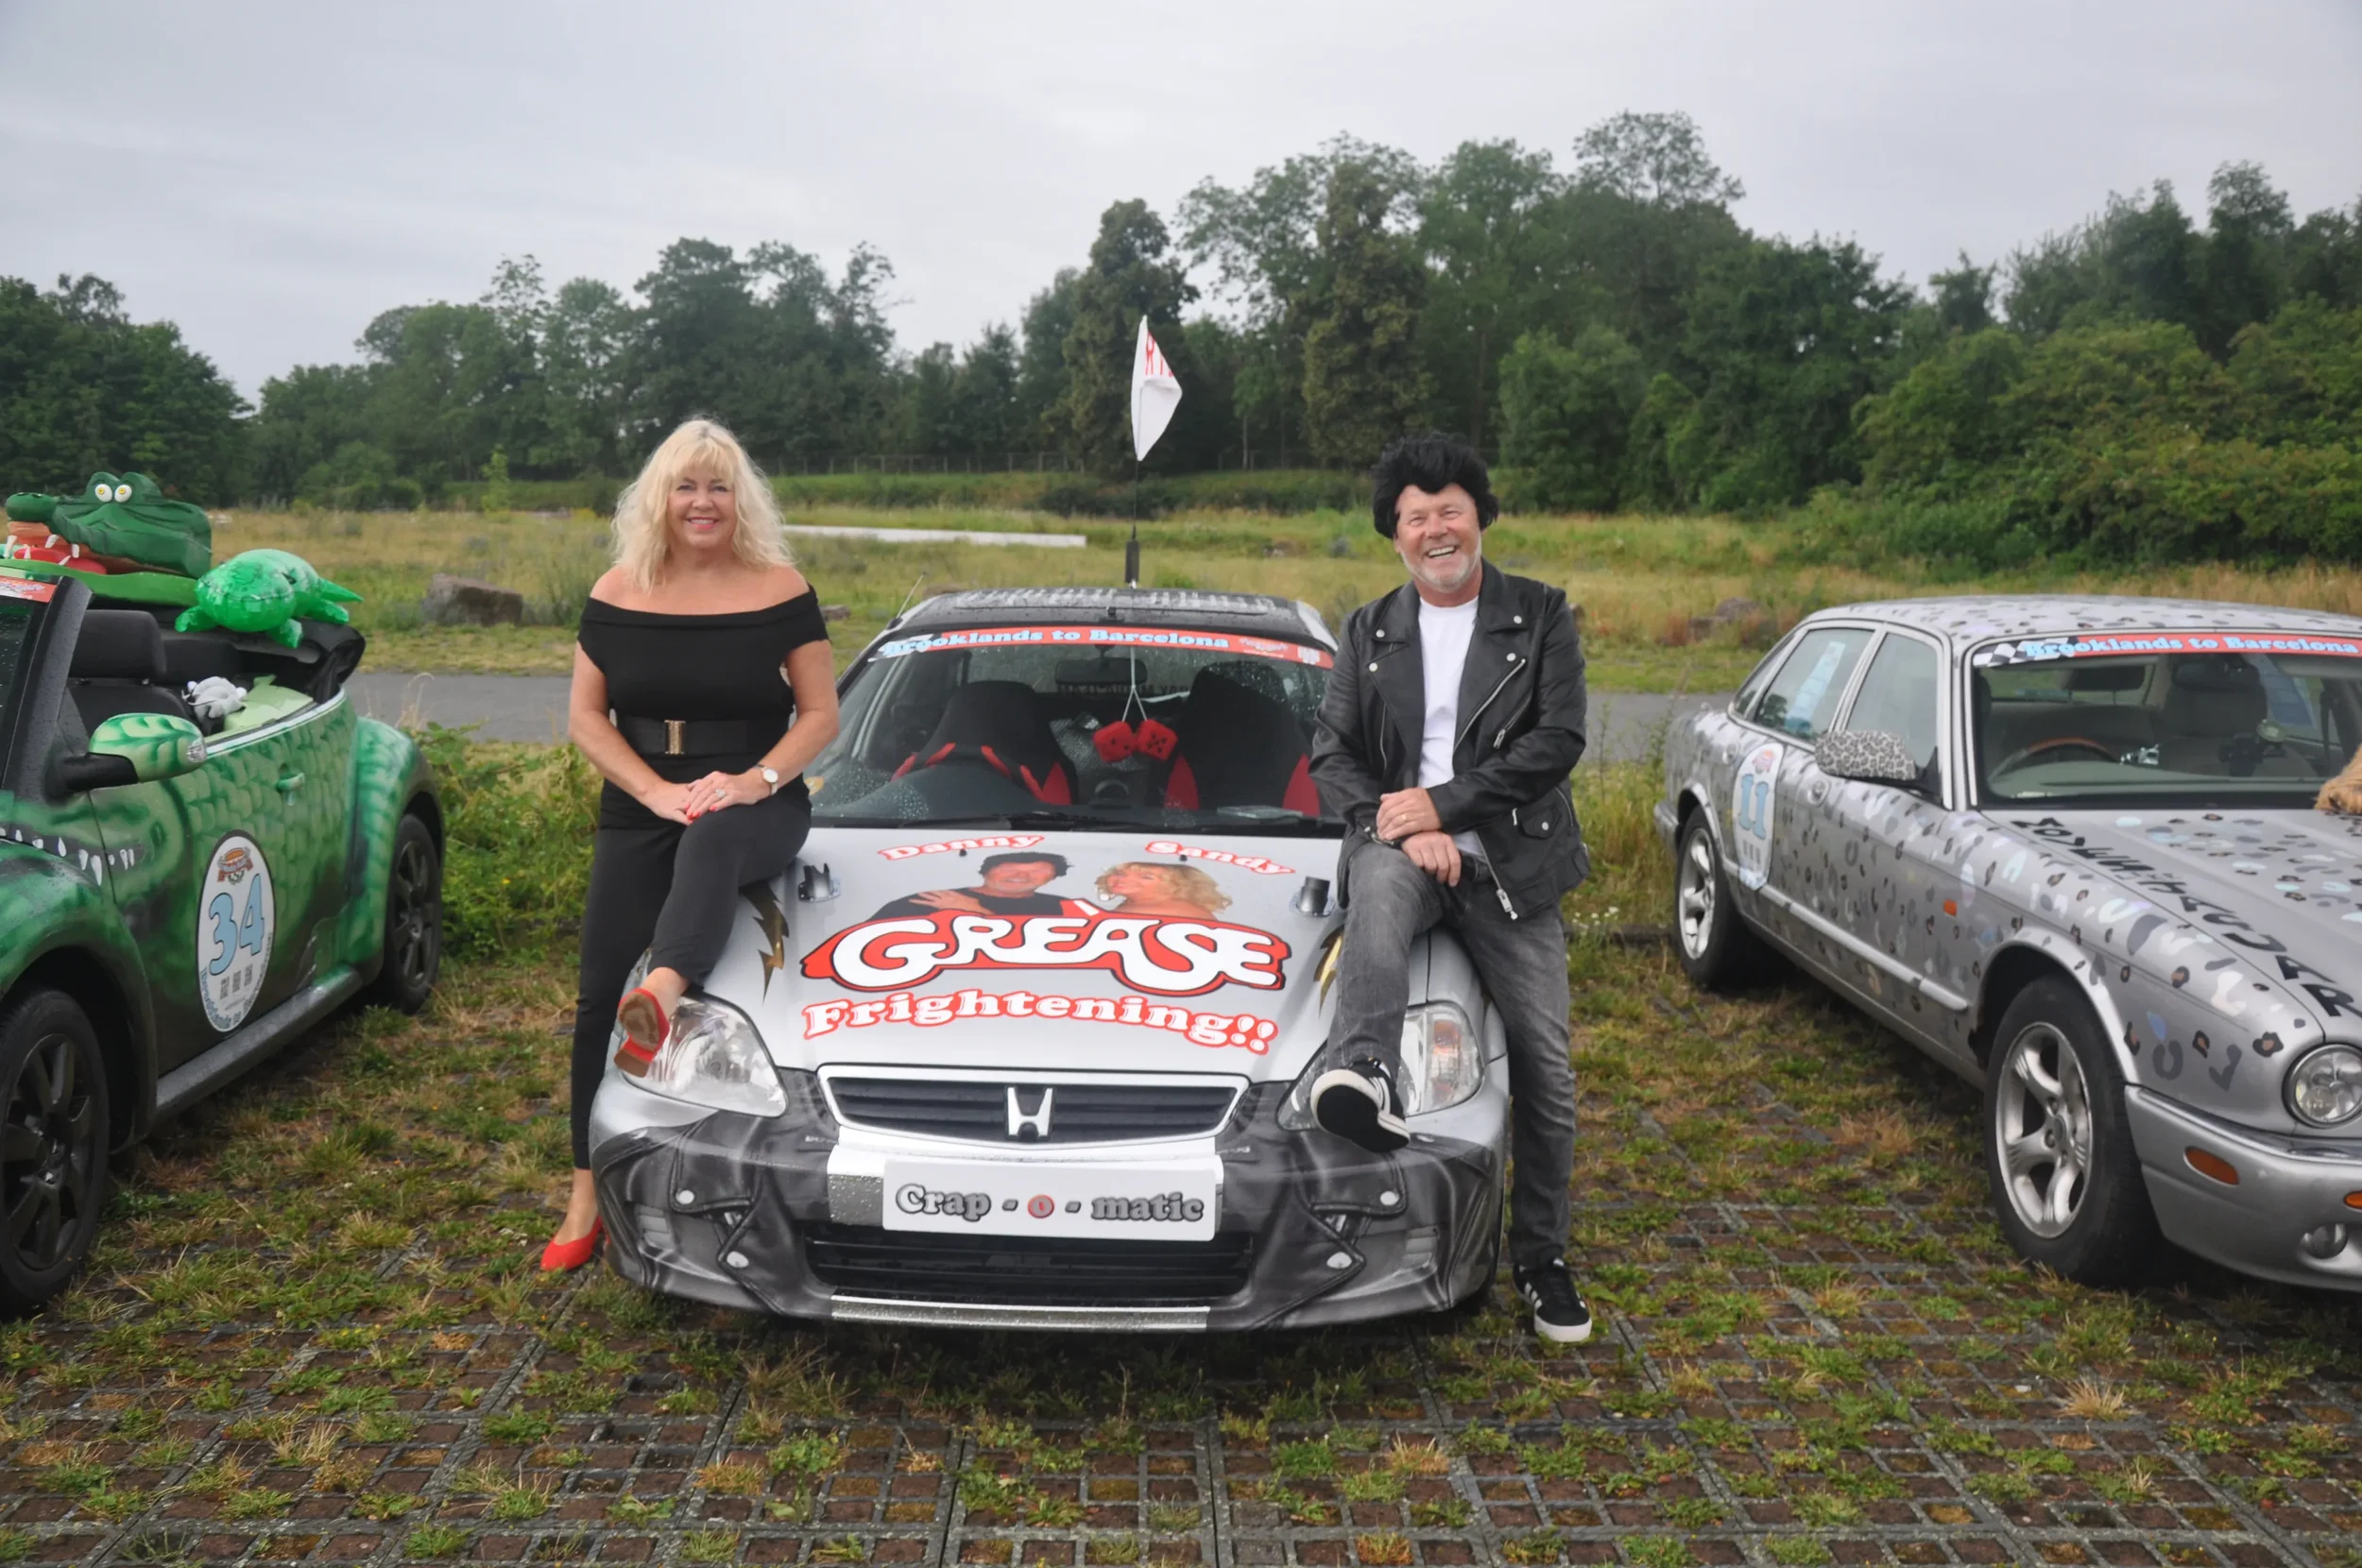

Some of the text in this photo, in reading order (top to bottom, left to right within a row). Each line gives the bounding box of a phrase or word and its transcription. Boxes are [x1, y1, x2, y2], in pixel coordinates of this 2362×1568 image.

[881, 630, 1043, 656] Brooklands
[1052, 630, 1081, 641] to
[1088, 629, 1229, 648] Barcelona
[2024, 637, 2359, 656] Brooklands to Barcelona
[878, 835, 1044, 861] Danny
[1145, 841, 1295, 875] Sandy
[209, 873, 265, 976] 34
[831, 914, 1281, 992] GREASE
[803, 989, 1278, 1054] Frightening!!
[896, 1183, 992, 1221] Crap
[1027, 1194, 1054, 1219] o
[1090, 1191, 1205, 1221] matic
